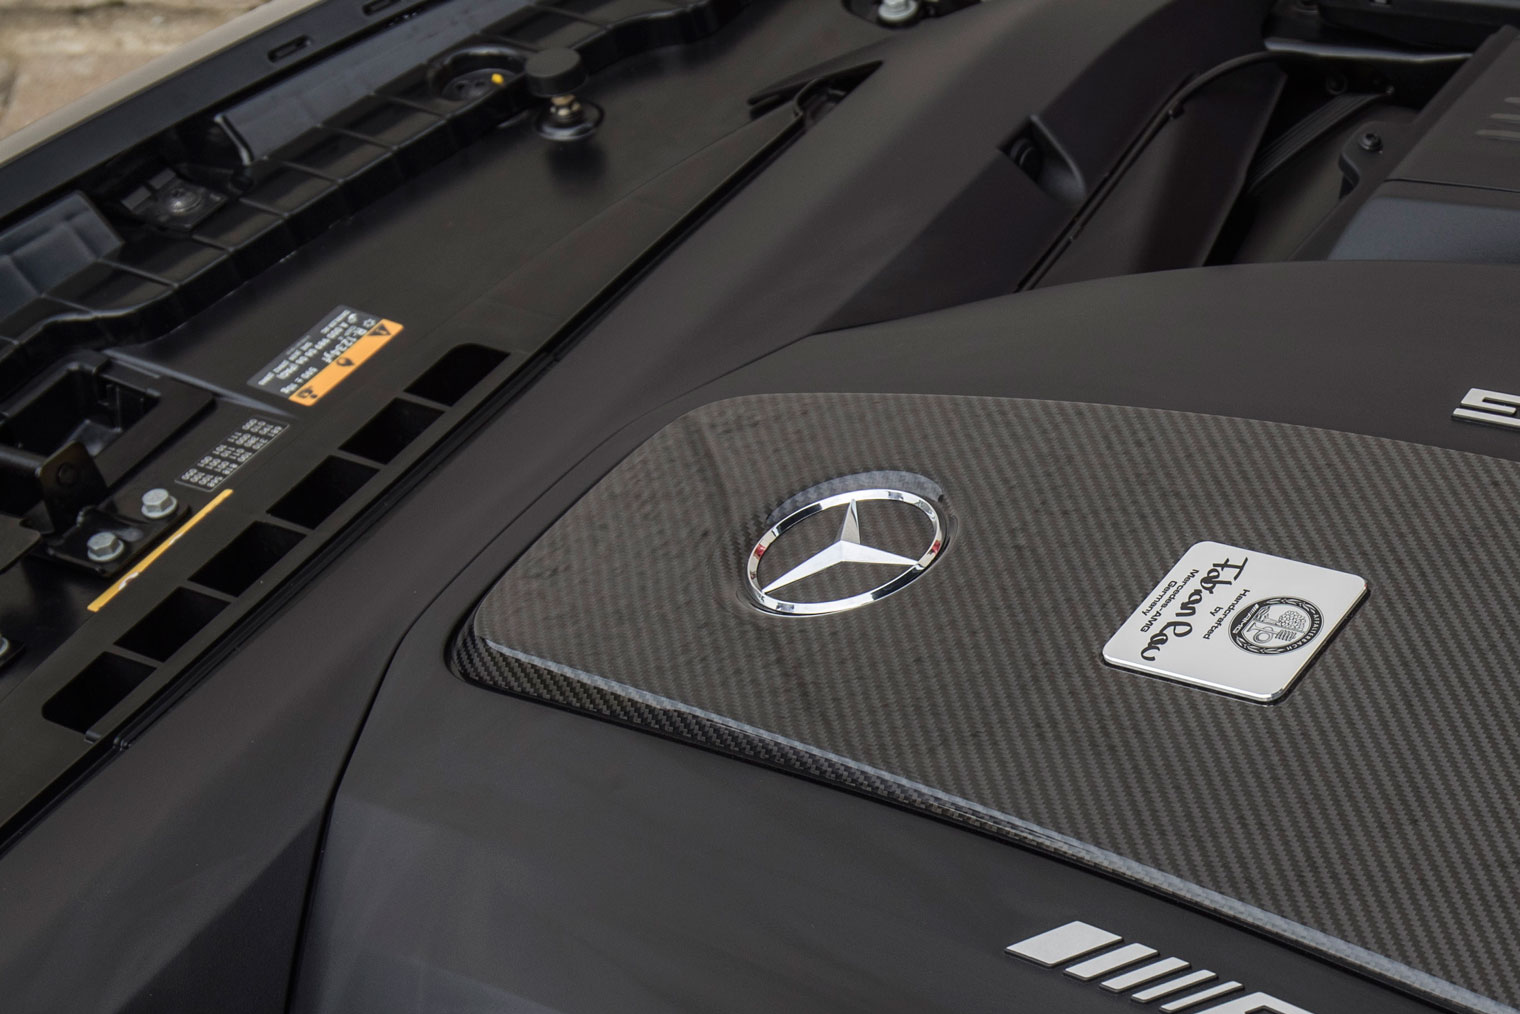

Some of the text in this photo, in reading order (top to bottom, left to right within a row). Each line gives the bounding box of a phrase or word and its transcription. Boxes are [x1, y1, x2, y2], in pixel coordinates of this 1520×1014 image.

[1140, 568, 1200, 633] Mercedes-AMG
[1141, 580, 1178, 617] Germany
[1203, 588, 1251, 640] Handcrafted
[1209, 606, 1224, 618] by
